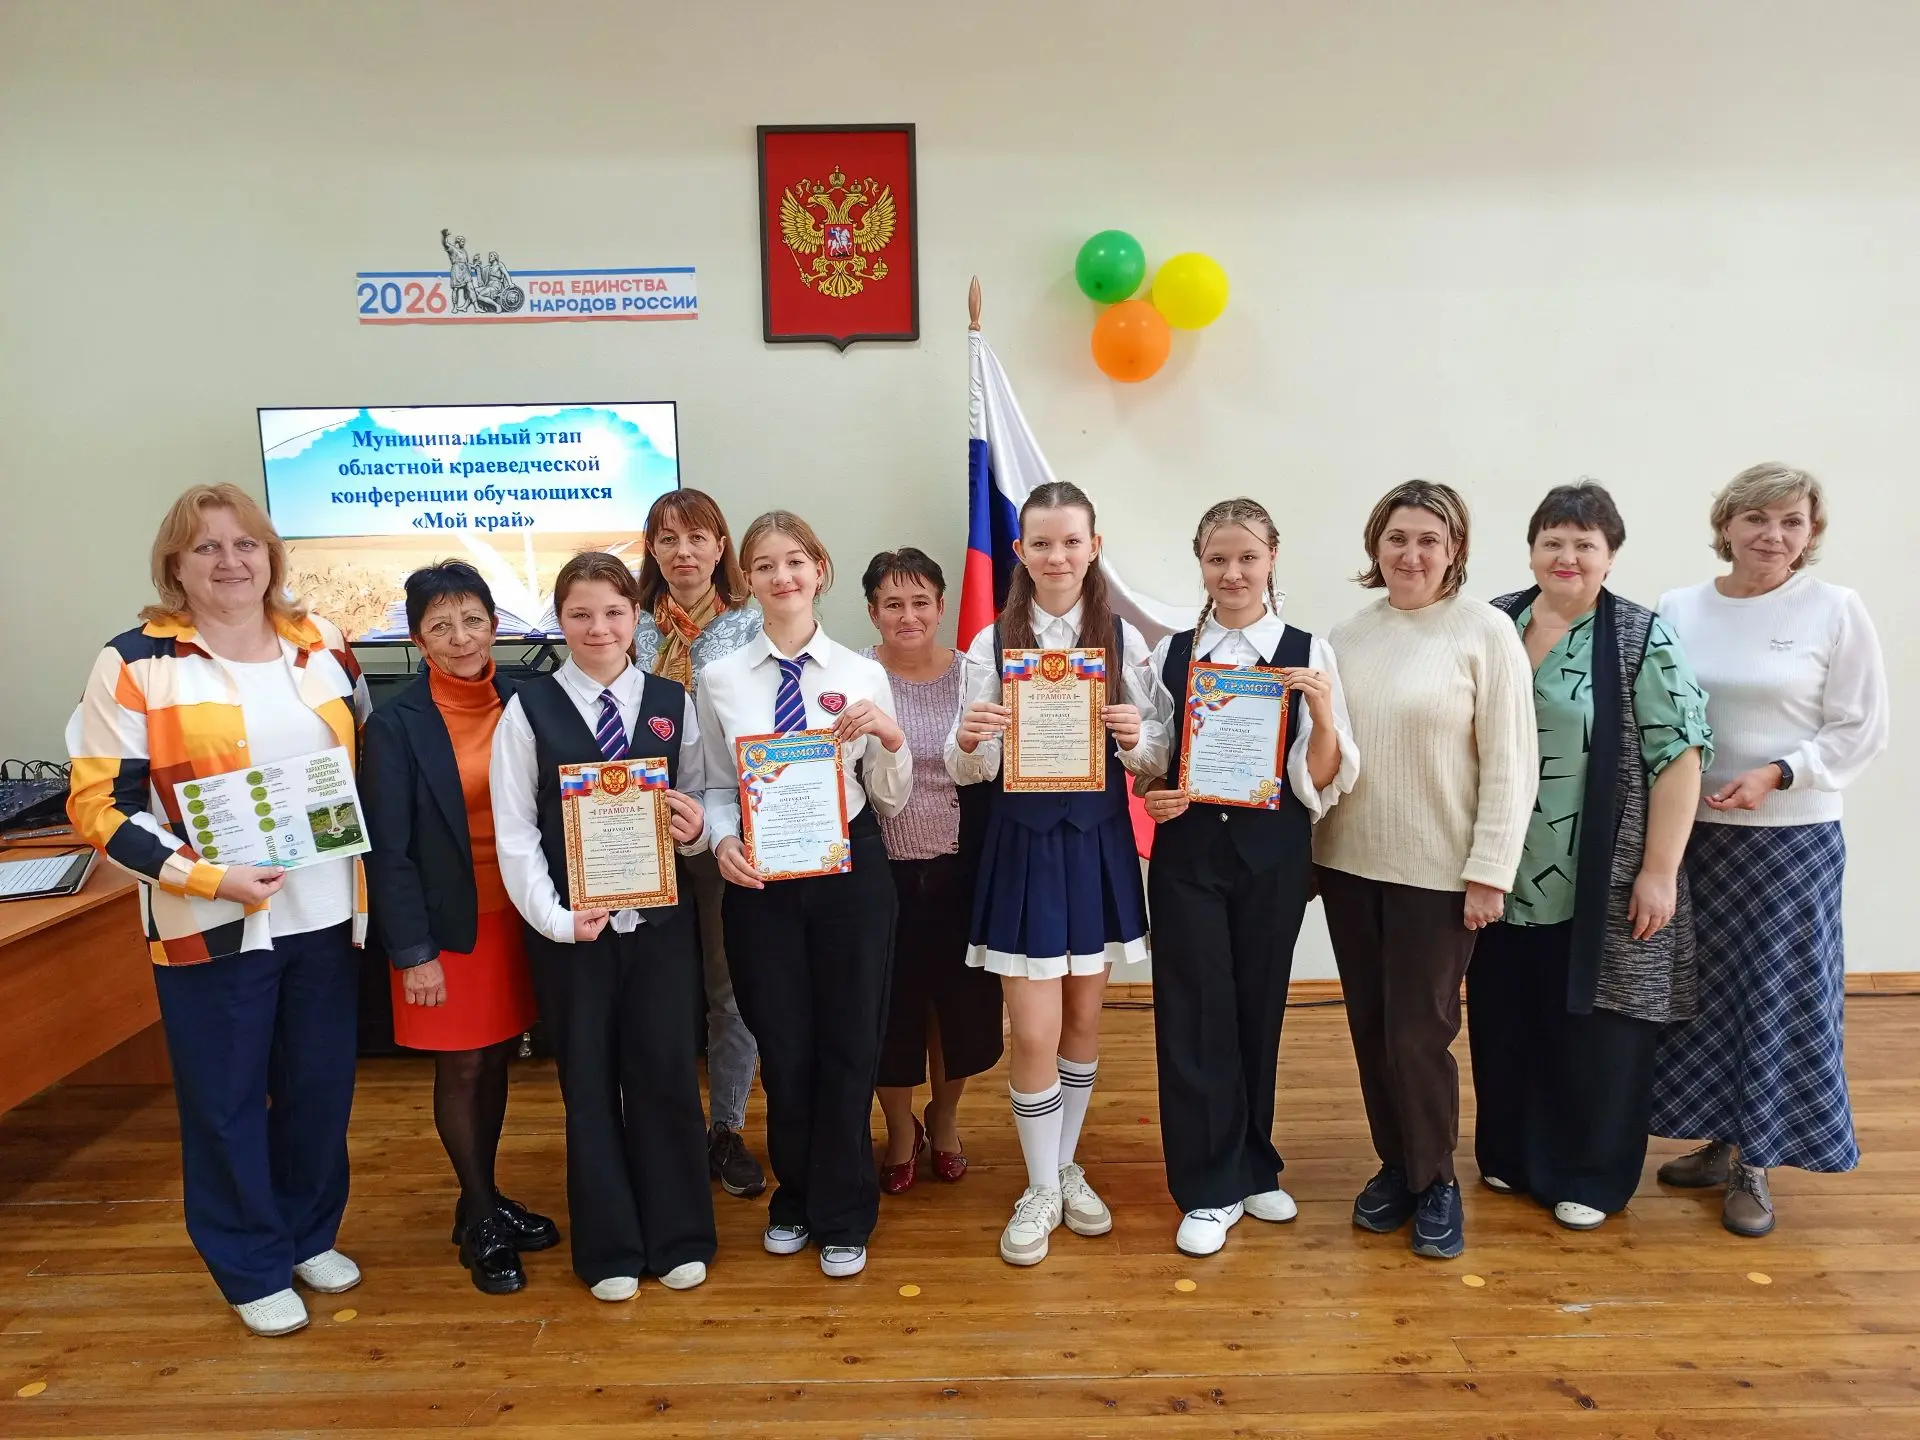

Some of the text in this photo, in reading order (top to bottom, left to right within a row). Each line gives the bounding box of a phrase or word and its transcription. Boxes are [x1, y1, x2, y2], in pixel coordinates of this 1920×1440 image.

[529, 278, 668, 297] ГОД ЕДИНСТВА
[357, 282, 448, 314] 2026
[530, 295, 698, 314] НАРОДОВ РОССИИ
[351, 428, 582, 452] Муниципальный этап
[338, 455, 600, 478] областной краеведческой
[331, 484, 613, 508] конференции обучающихся
[412, 511, 535, 532] «Мой край»
[1036, 693, 1072, 701] ГРАМОТА
[1224, 681, 1278, 694] ГРАМОТА
[775, 746, 830, 759] ГРАМОТА
[598, 806, 636, 816] ГРАМОТА
